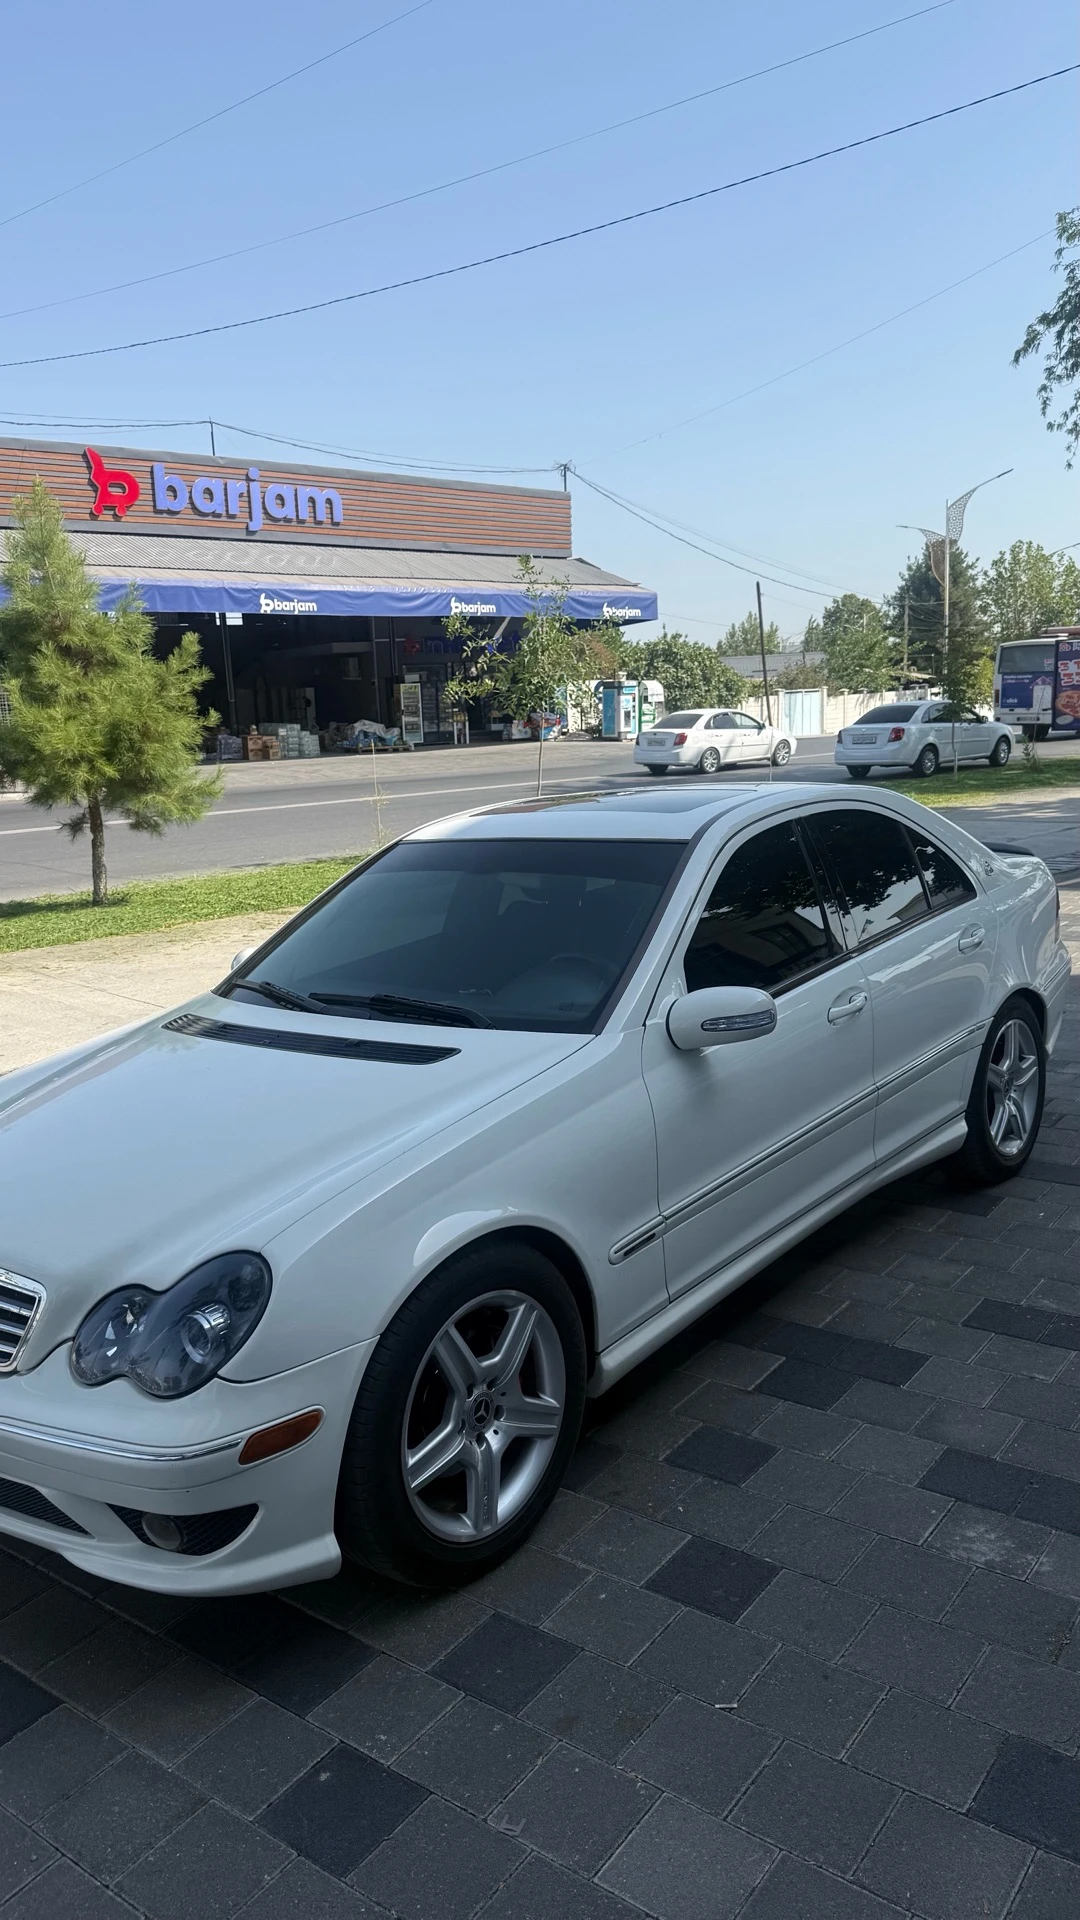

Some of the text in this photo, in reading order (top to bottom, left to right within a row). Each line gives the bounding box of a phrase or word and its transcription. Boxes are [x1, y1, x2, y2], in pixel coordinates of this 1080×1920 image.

[152, 463, 343, 531] barjam
[274, 599, 317, 614] barjam
[462, 601, 496, 616] barjam
[612, 606, 641, 619] barjam
